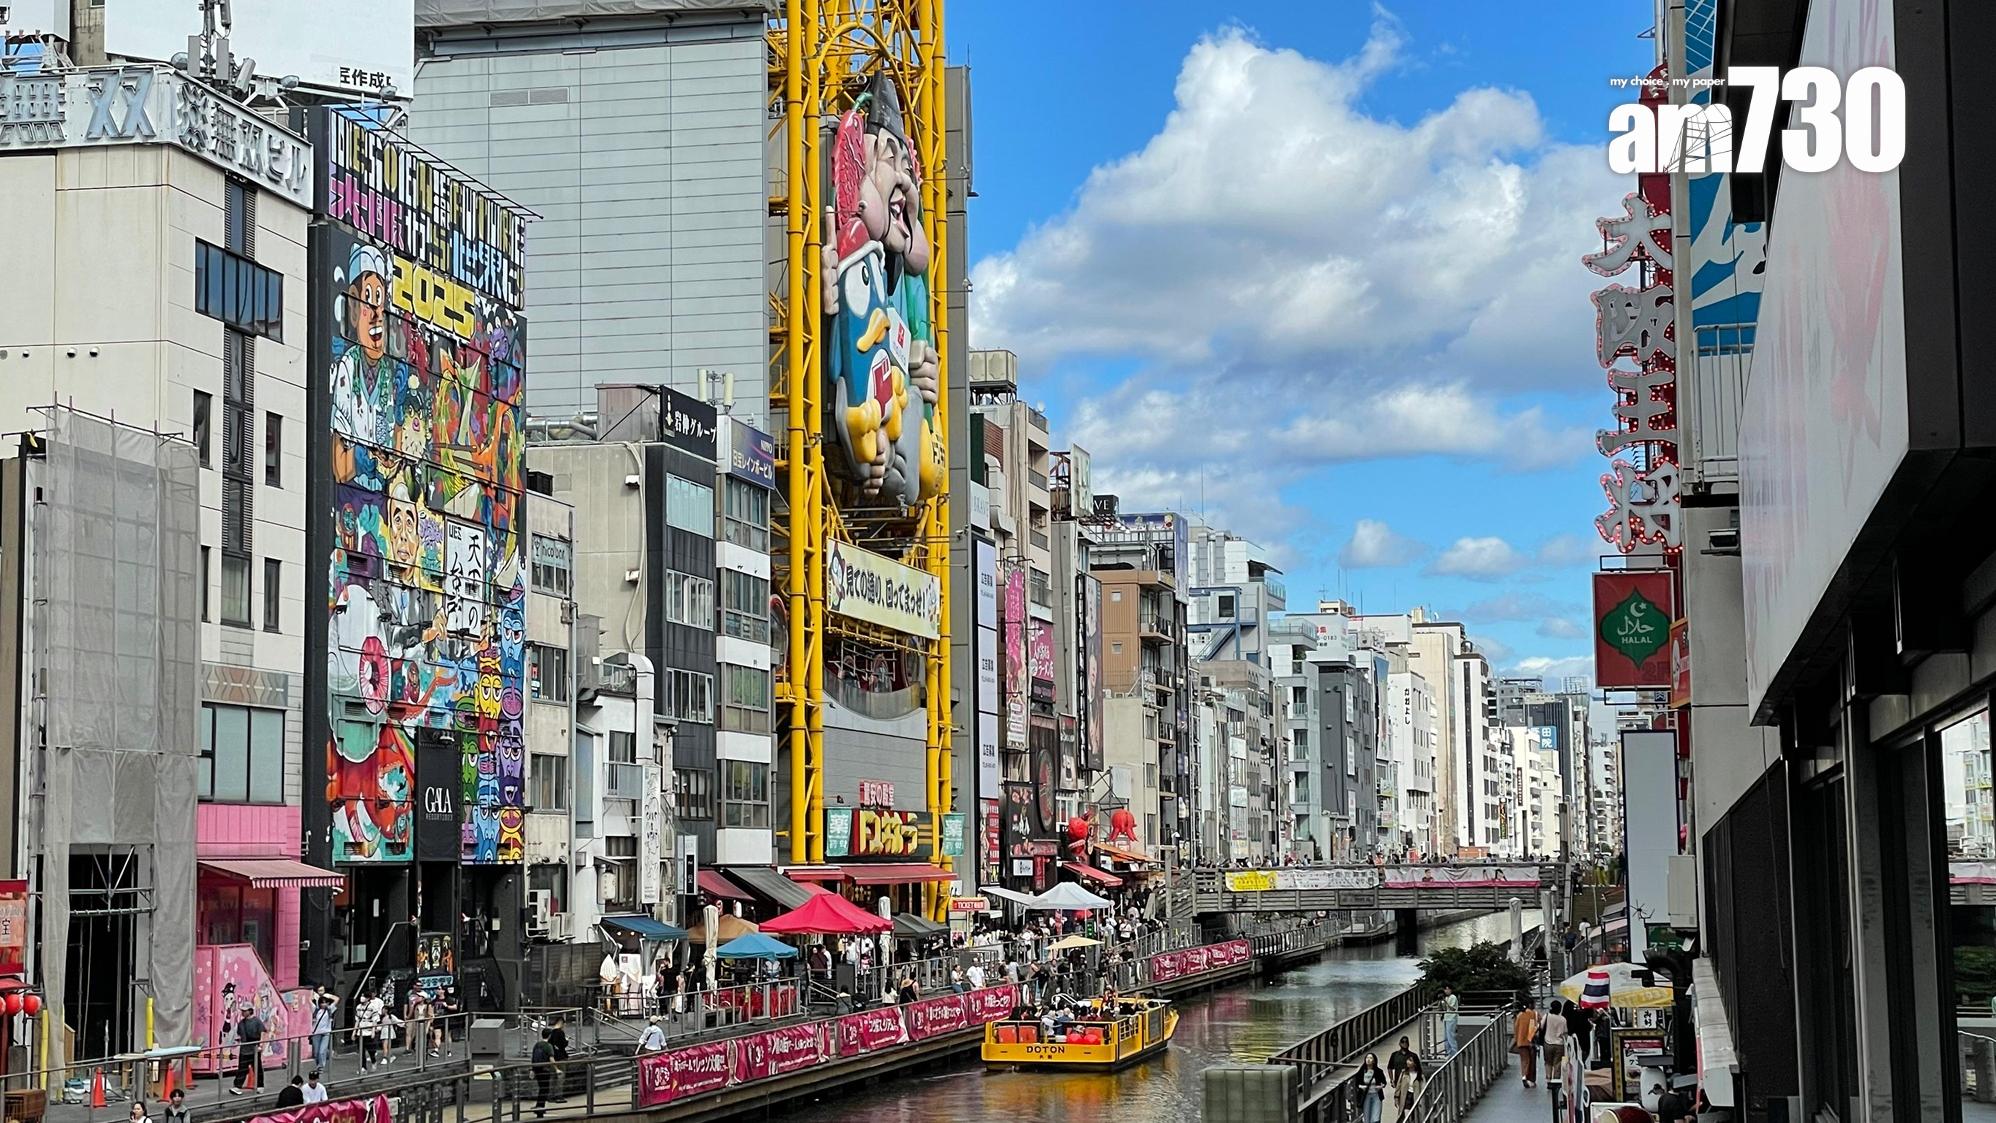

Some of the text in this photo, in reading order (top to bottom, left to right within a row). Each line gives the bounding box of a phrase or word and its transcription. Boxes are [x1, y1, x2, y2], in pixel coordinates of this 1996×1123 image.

[391, 256, 475, 341] 2025
[1617, 615, 1655, 636] حلال
[1621, 636, 1653, 644] HALAL
[425, 786, 452, 813] GALA
[1026, 1045, 1065, 1054] DOTON
